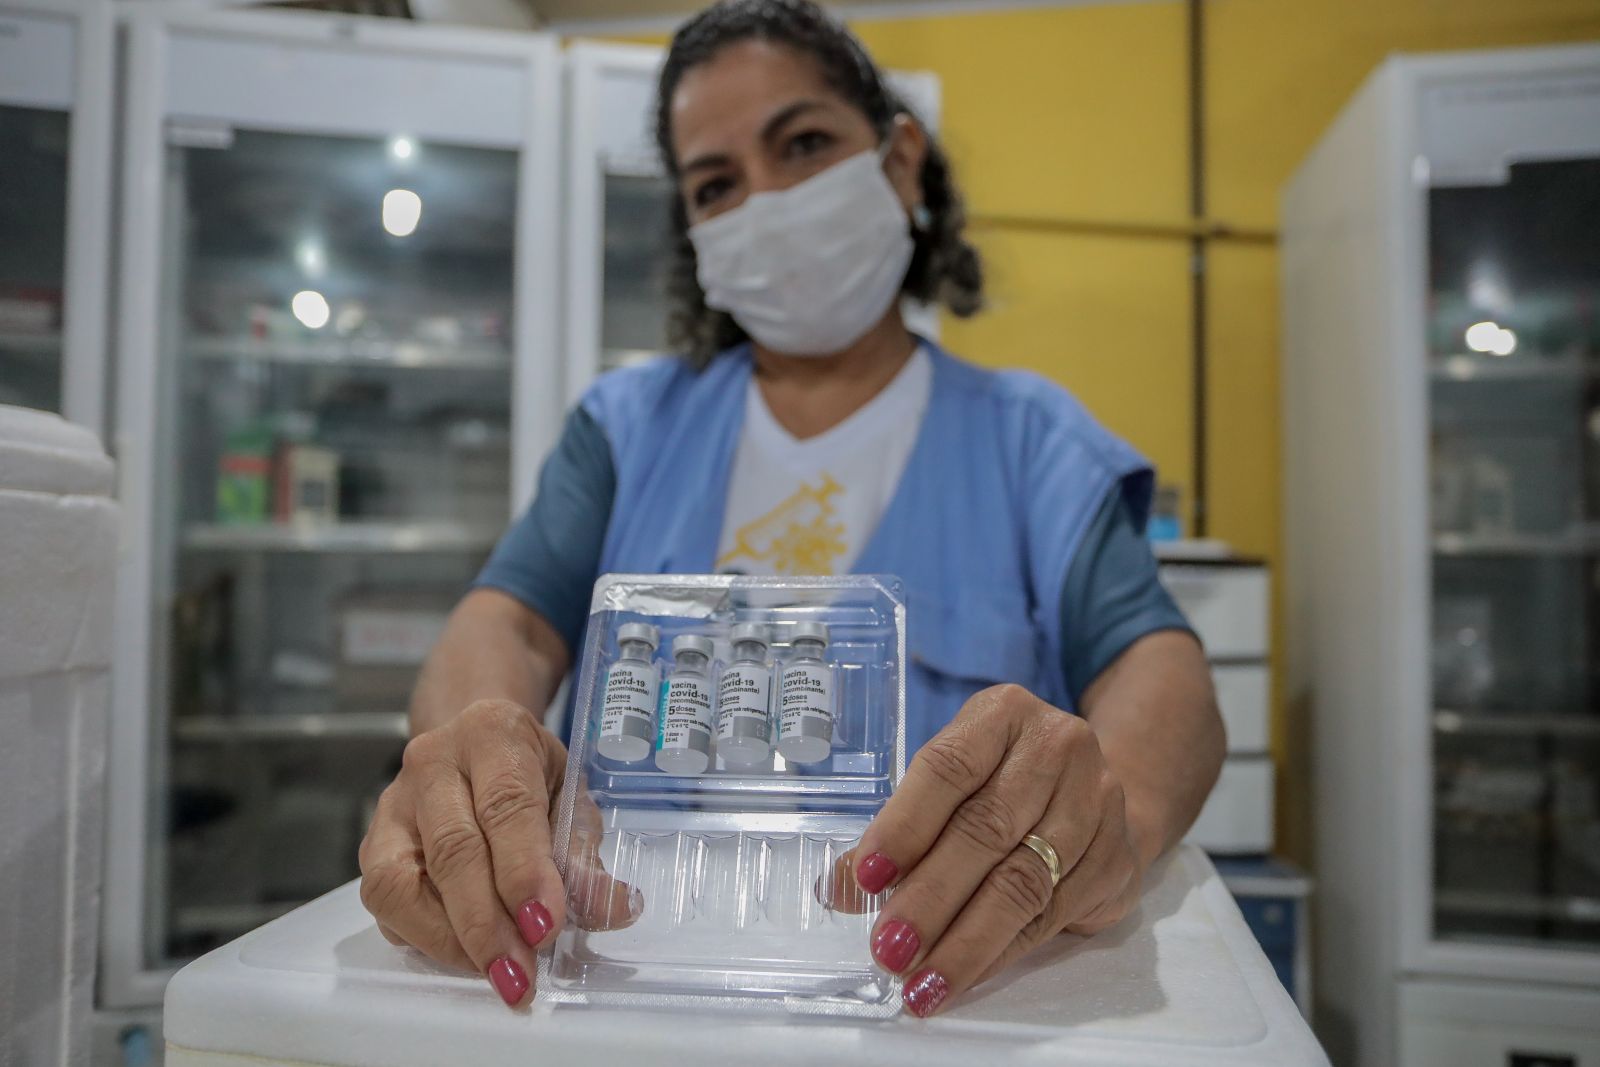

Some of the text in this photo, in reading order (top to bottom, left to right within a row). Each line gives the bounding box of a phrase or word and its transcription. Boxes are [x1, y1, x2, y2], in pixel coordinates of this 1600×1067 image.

[608, 677, 645, 687] covid-19
[671, 681, 697, 689] vacina
[784, 677, 821, 688] covid-19
[606, 695, 612, 704] 5
[670, 690, 708, 701] covid-19
[783, 696, 788, 706] 5
[668, 705, 675, 715] 5
[676, 705, 696, 713] doses
